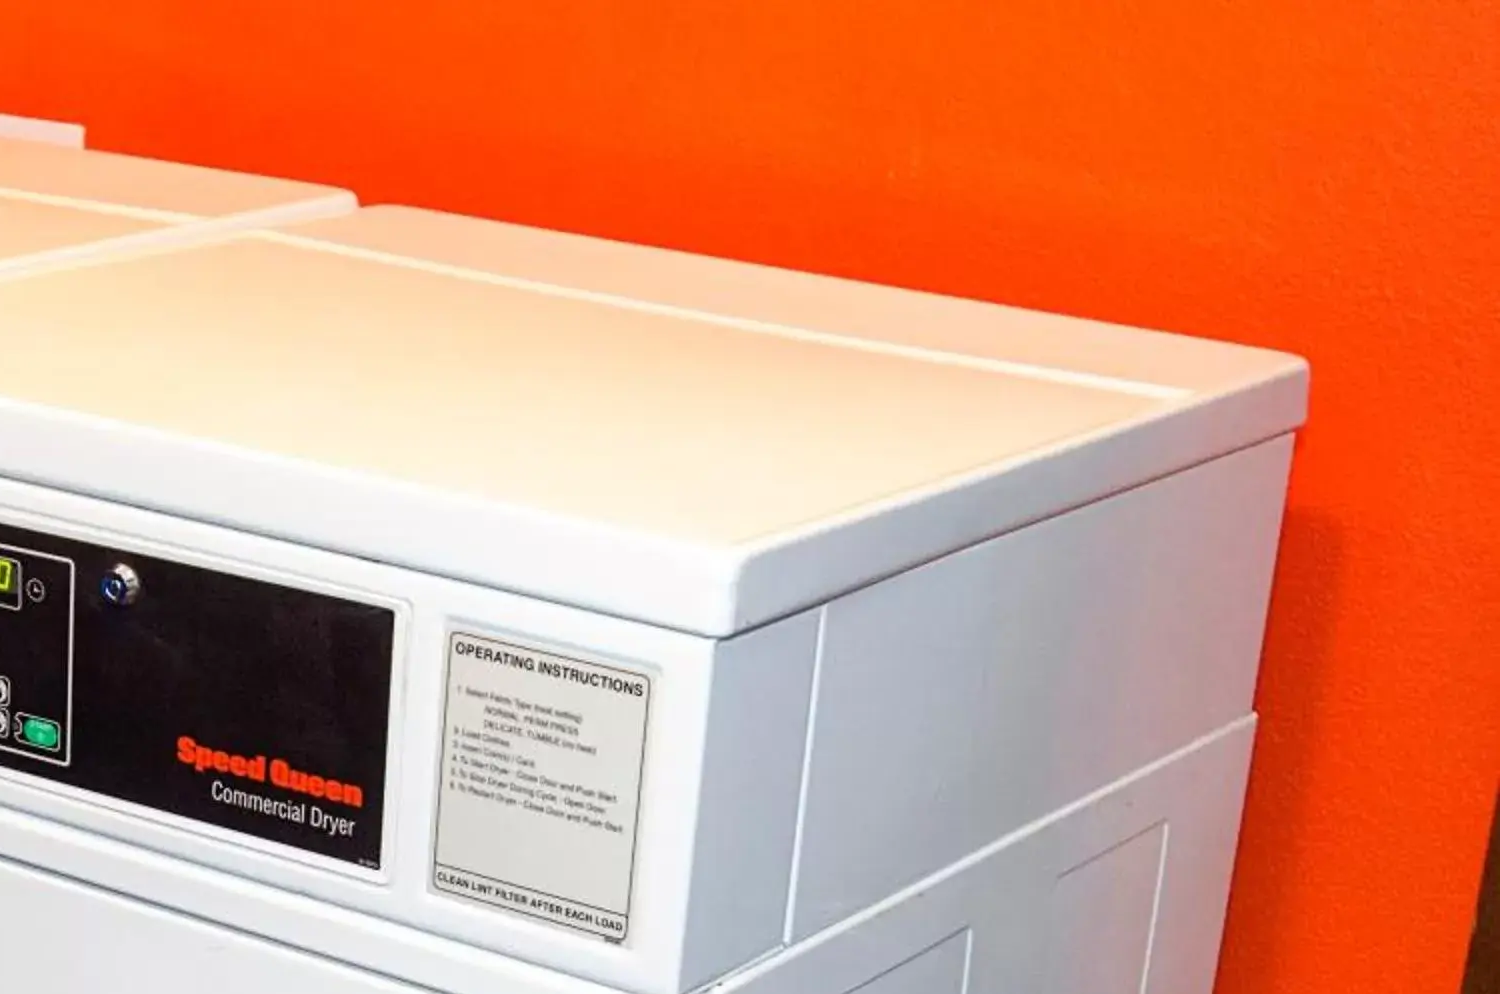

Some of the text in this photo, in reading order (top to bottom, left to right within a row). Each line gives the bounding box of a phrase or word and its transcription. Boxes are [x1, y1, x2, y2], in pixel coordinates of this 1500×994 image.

[455, 641, 643, 697] OPERATING INSTRUCTIONS
[177, 736, 363, 807] Speed Queen
[211, 779, 356, 838] Commercial Dryer
[437, 872, 623, 933] CLEAN LINT FILTER AFTER EACH LOAD
